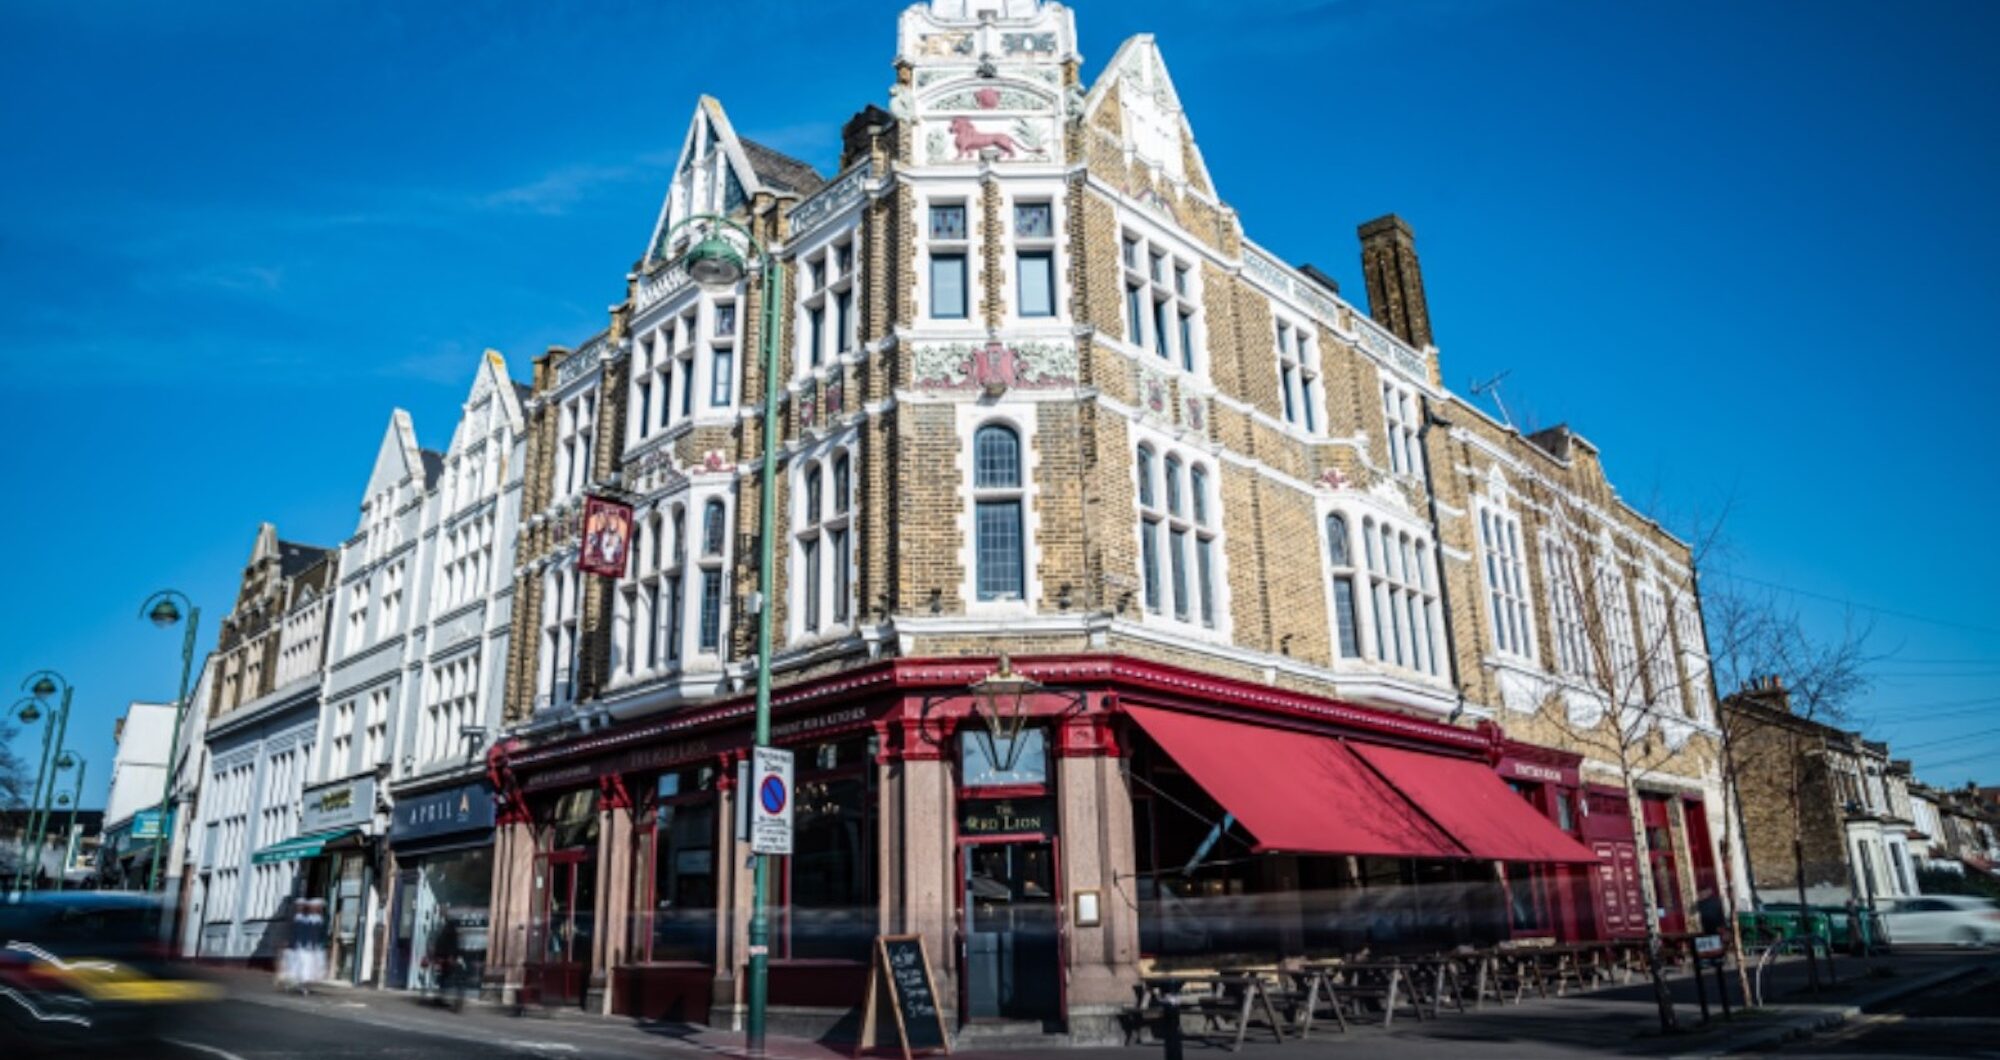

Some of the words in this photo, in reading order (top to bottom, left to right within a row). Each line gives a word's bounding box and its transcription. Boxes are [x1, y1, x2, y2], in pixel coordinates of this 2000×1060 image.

[409, 802, 451, 825] APRIL
[967, 816, 998, 831] RED
[1003, 815, 1041, 831] LION
